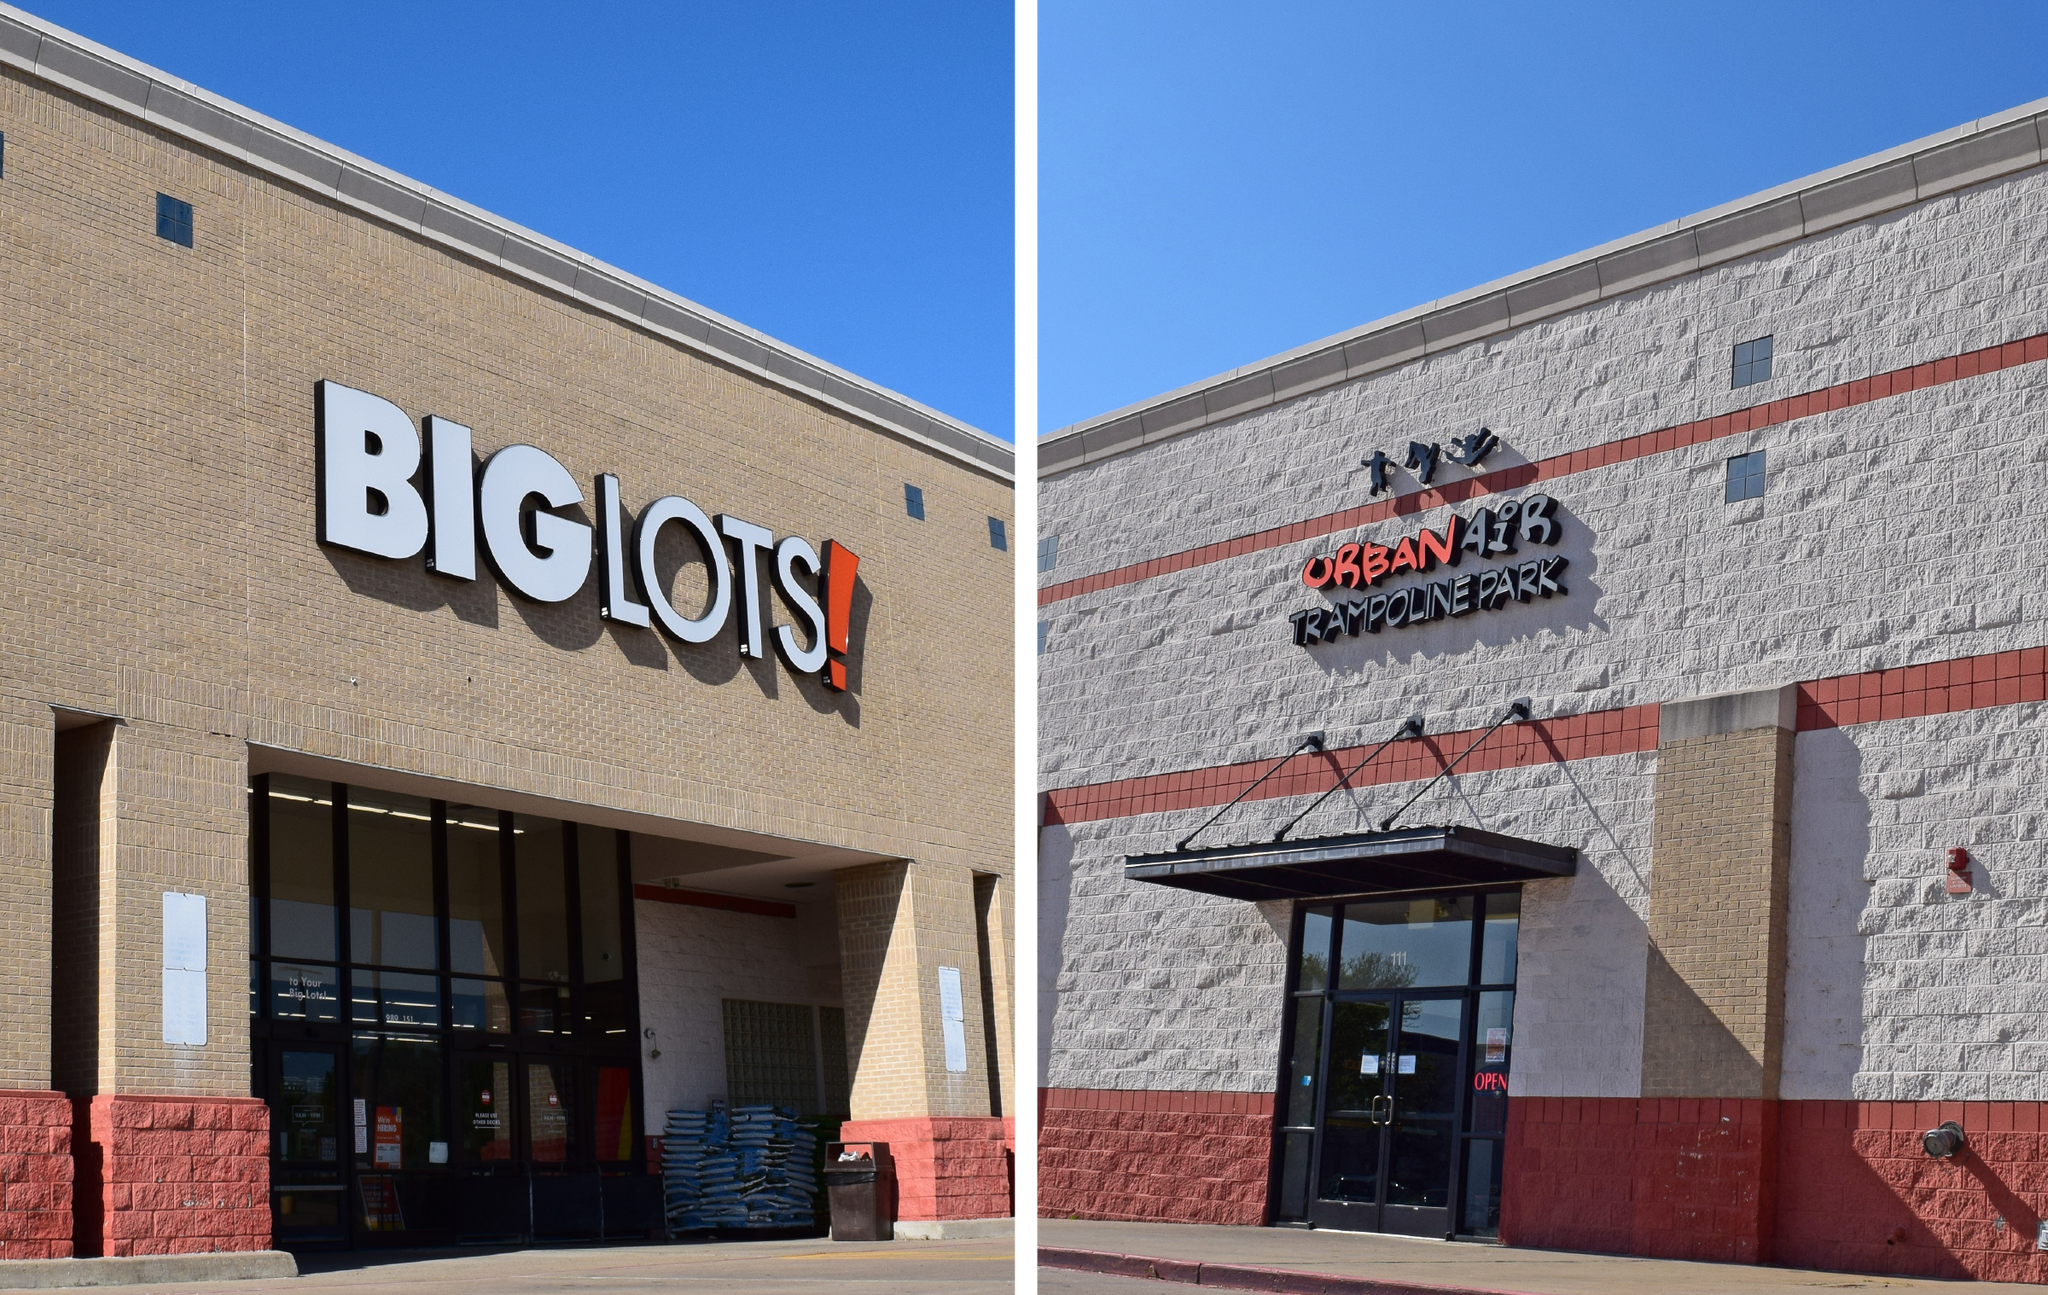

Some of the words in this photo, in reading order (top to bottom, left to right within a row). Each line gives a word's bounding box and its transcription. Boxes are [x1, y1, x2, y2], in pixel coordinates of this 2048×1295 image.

[315, 378, 592, 603] BIG
[595, 473, 860, 692] LOTS!
[1303, 514, 1464, 589] URBAN
[1289, 573, 1478, 646] TRAMPOLINE
[1478, 555, 1569, 611] PARK
[1391, 951, 1407, 966] 111
[289, 977, 298, 986] to
[301, 977, 322, 988] Your
[289, 988, 303, 1001] Big
[306, 989, 327, 1000] Lots!
[1474, 1072, 1508, 1091] OPEN
[377, 1124, 397, 1133] HIRING
